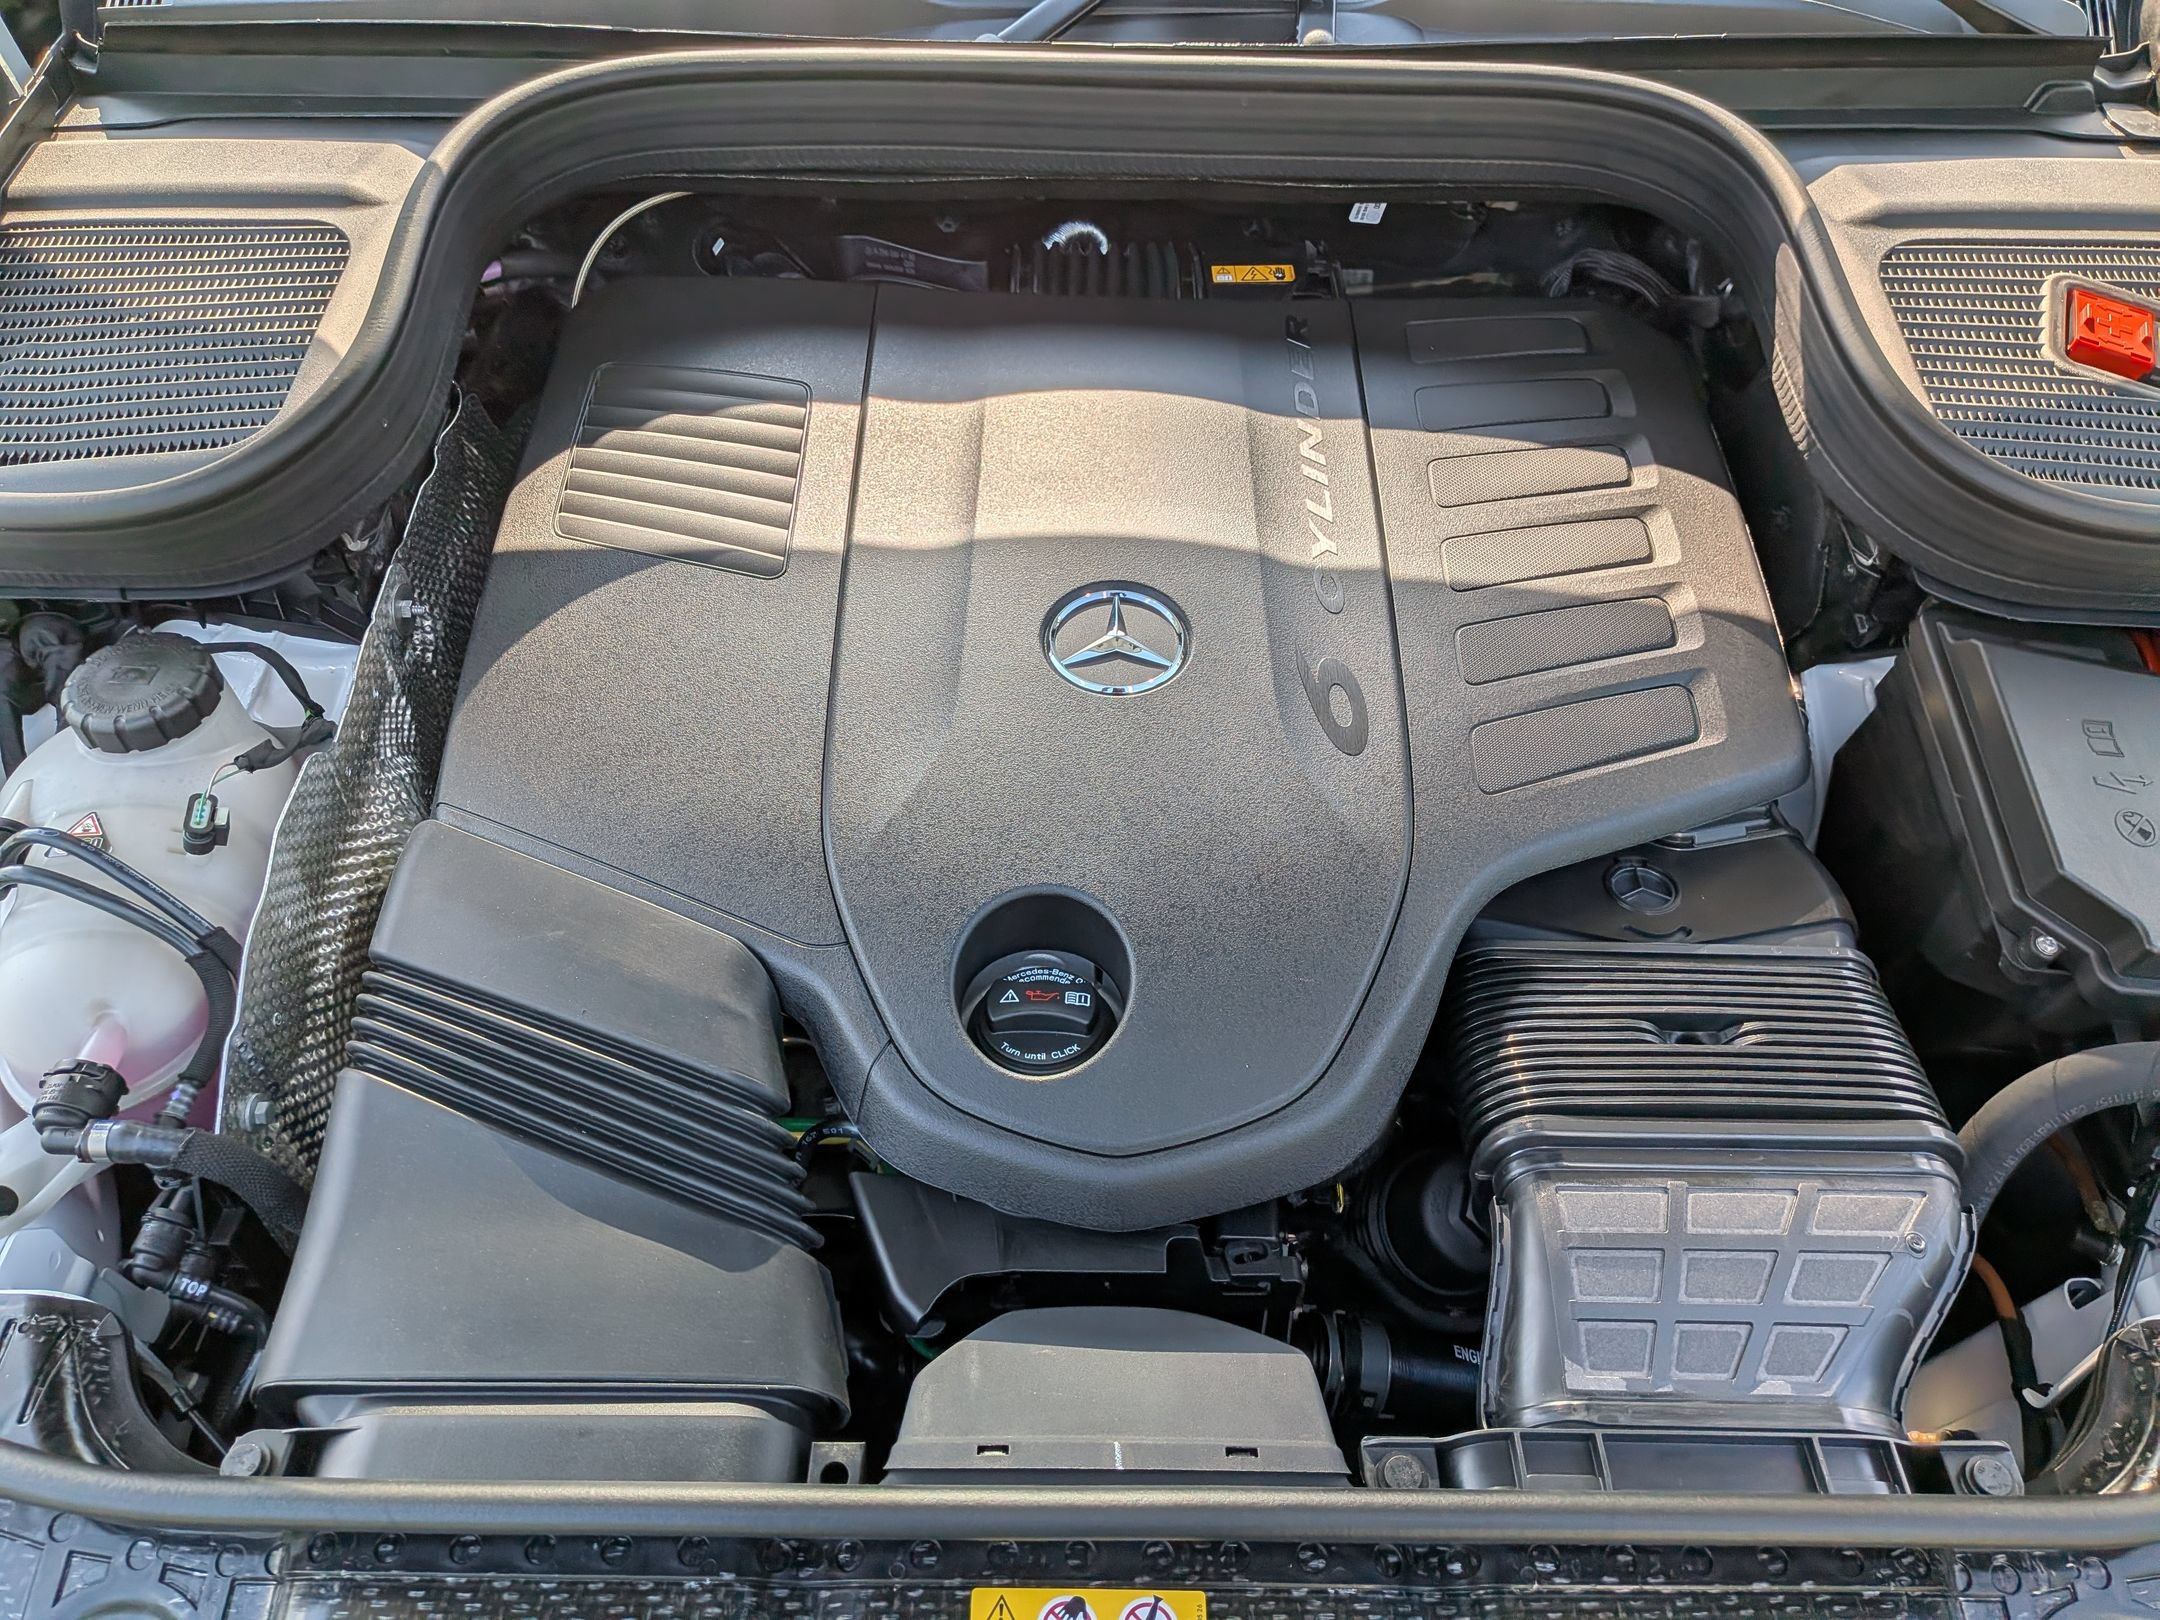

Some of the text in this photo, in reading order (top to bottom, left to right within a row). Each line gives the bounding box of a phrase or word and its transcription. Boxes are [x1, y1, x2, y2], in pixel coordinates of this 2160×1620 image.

[1285, 314, 1369, 756] 6 CYLINDER
[1000, 1042, 1081, 1060] Turn until CLICK
[179, 1278, 208, 1297] TOP
